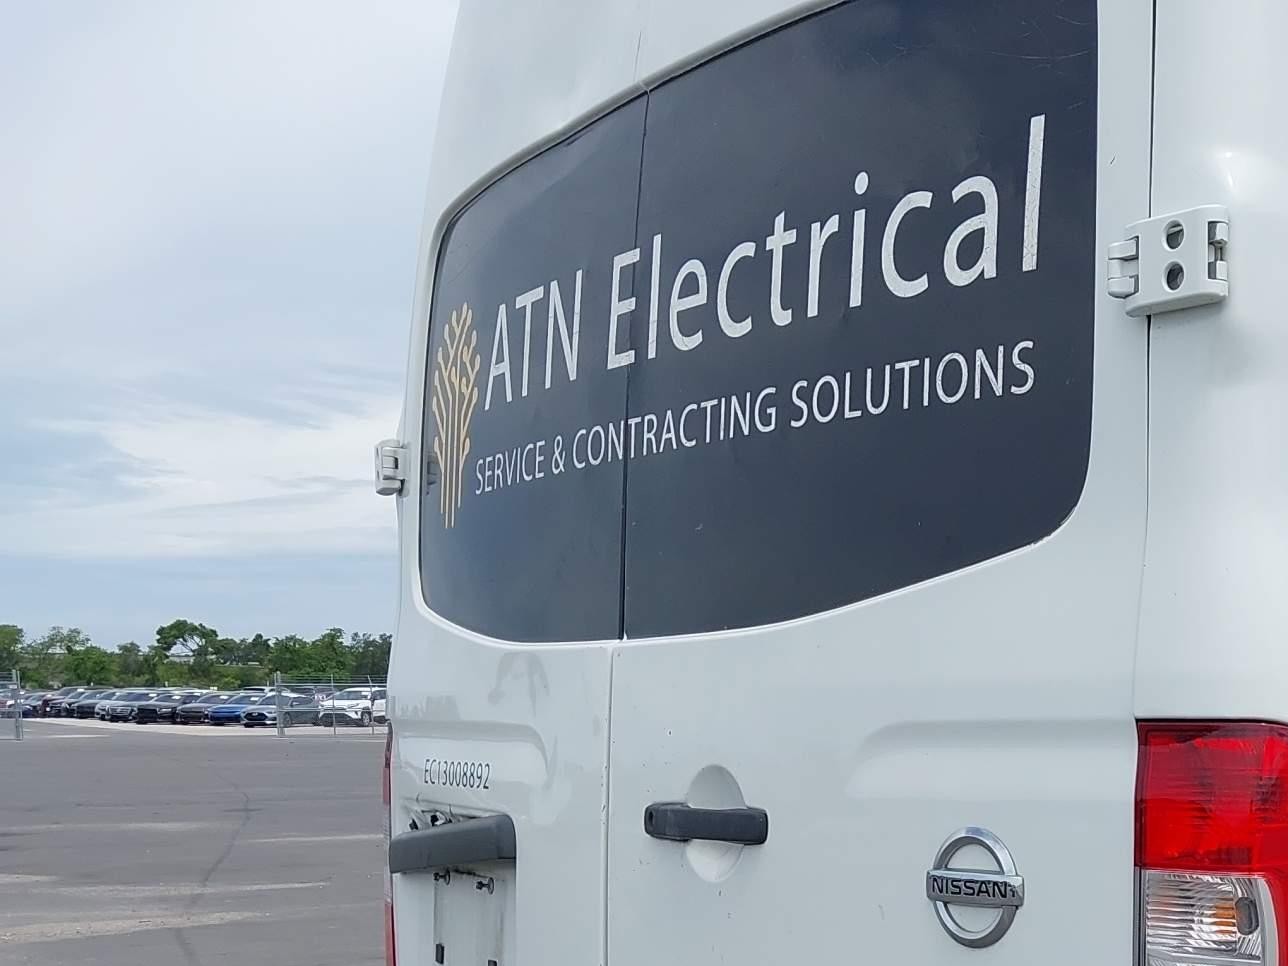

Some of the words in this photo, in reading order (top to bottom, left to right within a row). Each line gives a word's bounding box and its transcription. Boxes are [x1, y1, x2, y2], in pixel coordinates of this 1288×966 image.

[484, 269, 583, 411] ATN
[606, 114, 1046, 370] Electrical
[475, 440, 546, 495] SERVICE
[552, 435, 567, 475] &
[572, 387, 777, 469] CONTRACTING
[790, 340, 1035, 428] SOLUTIONS
[424, 758, 490, 789] EC13008892
[931, 875, 1009, 899] NISSAN
